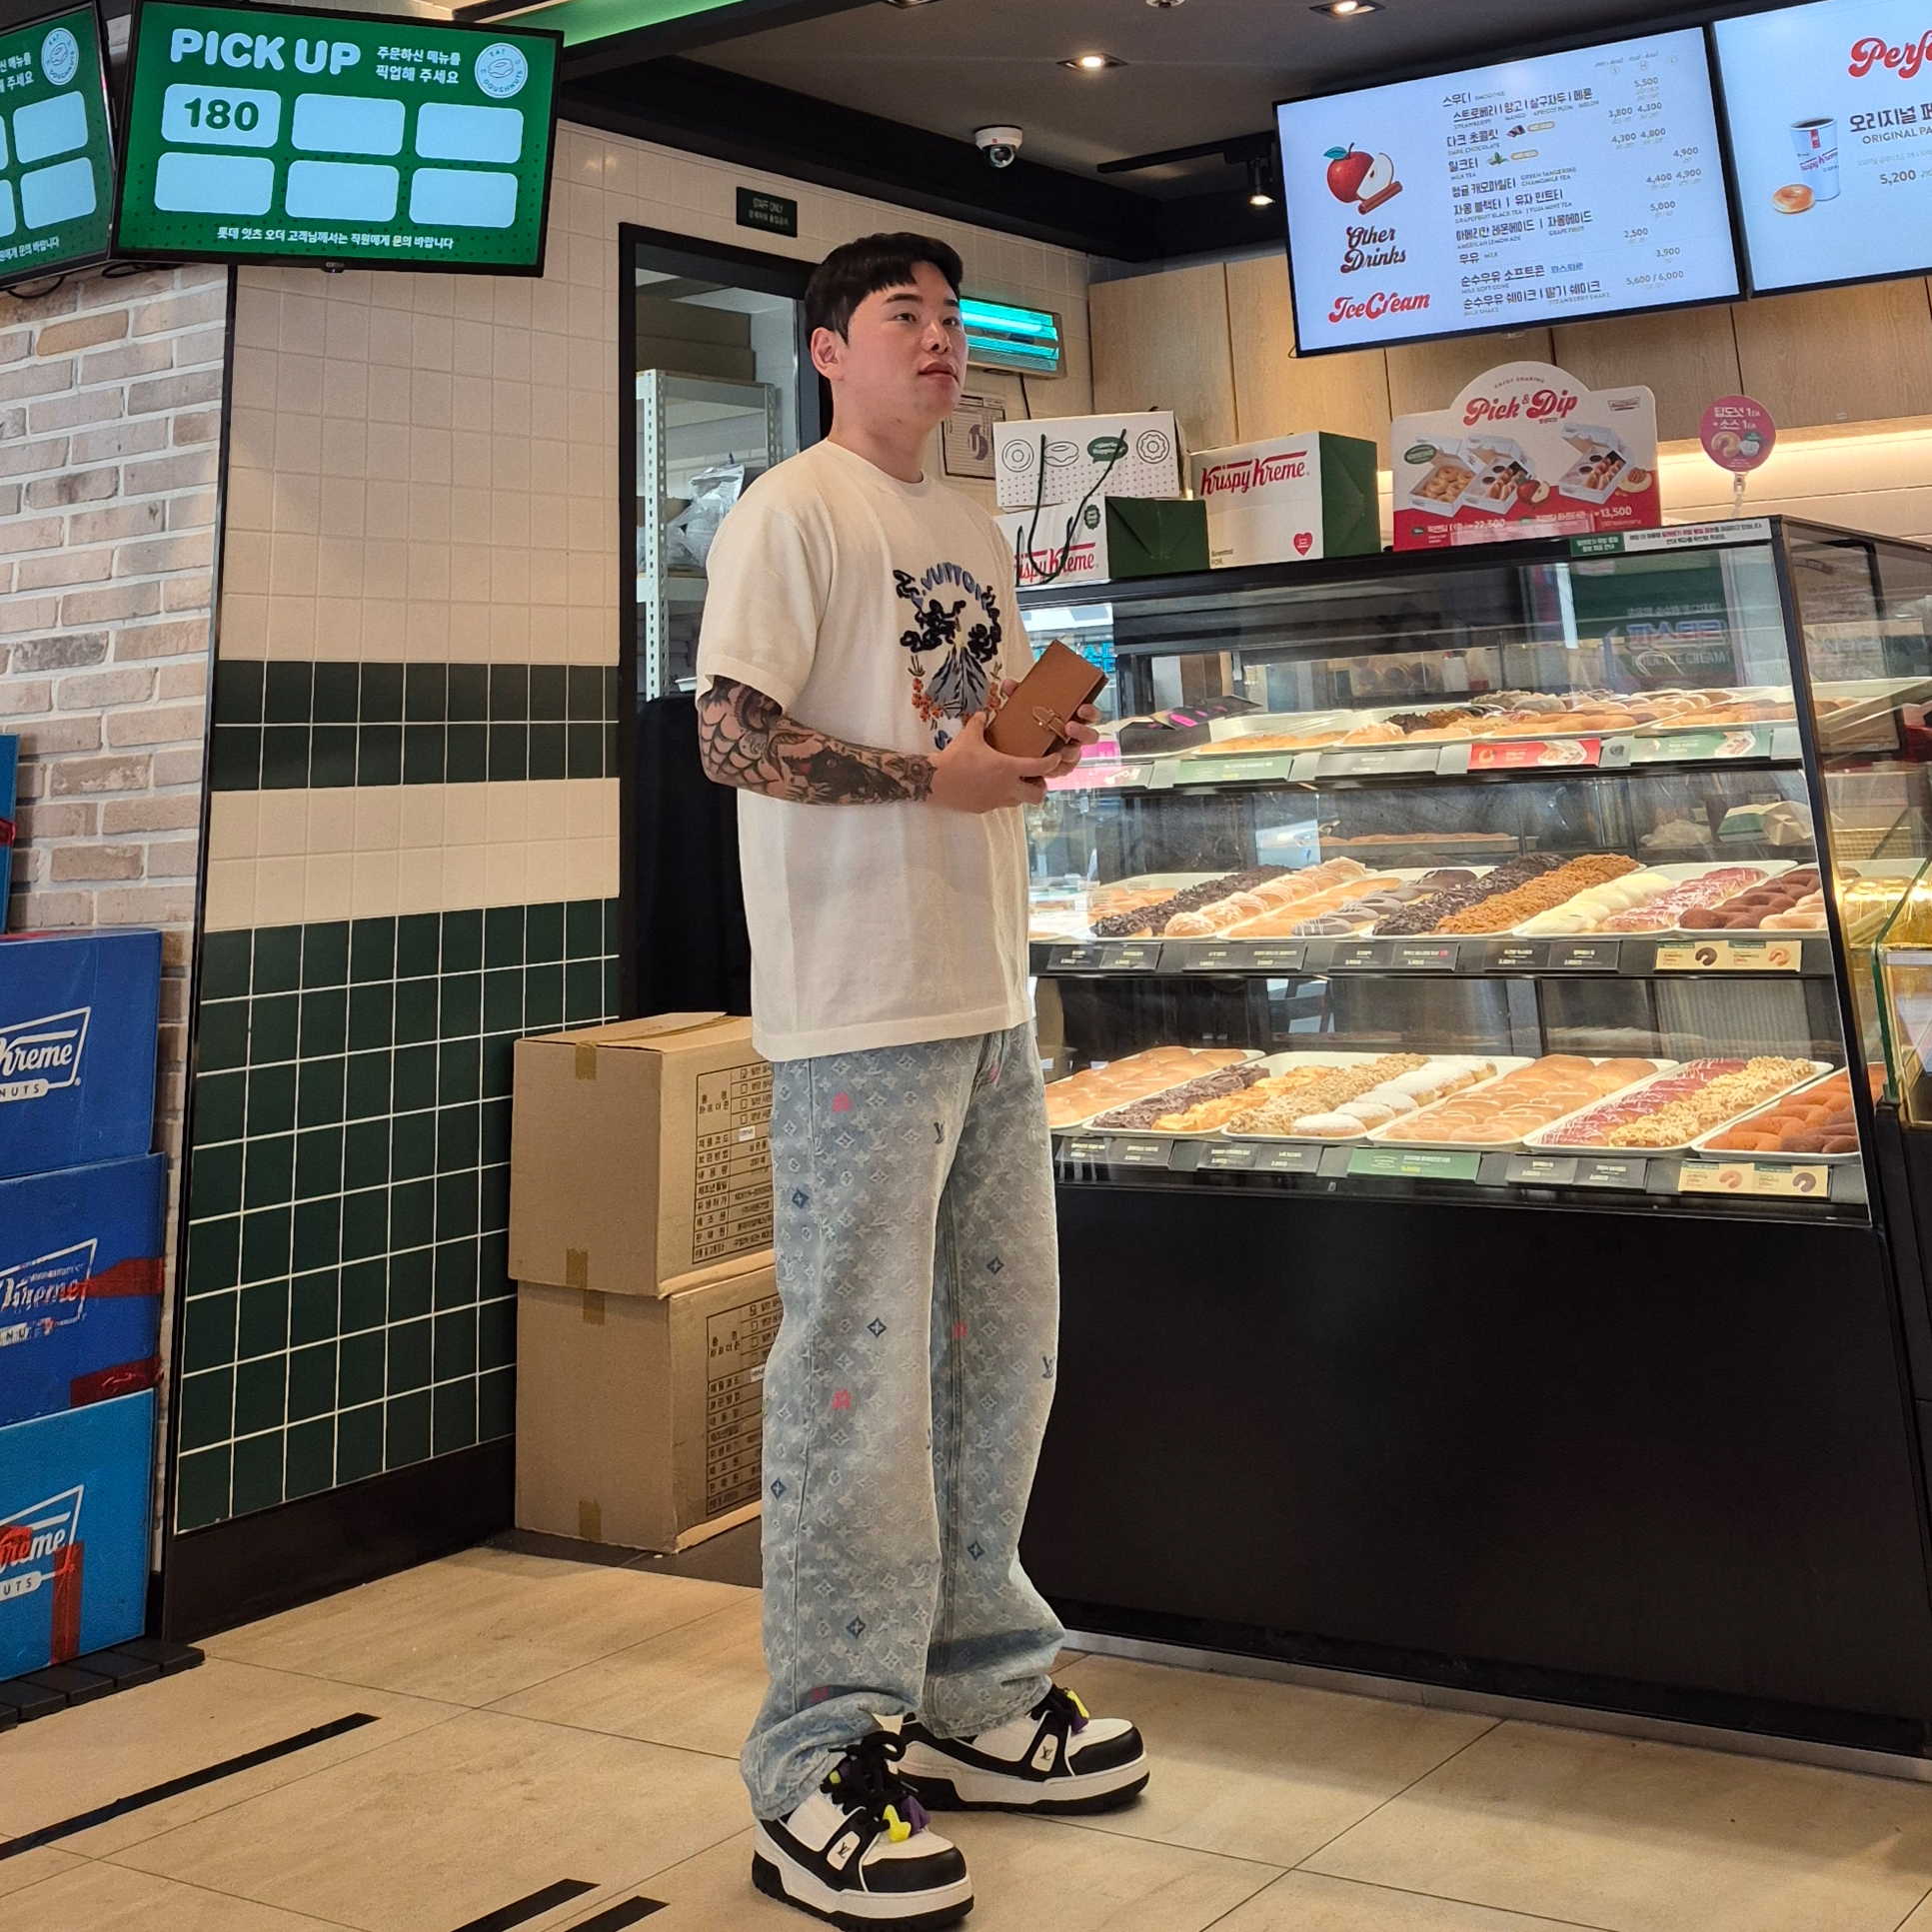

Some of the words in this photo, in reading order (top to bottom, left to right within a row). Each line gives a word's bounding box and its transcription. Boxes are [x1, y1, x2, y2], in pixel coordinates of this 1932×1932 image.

[170, 28, 285, 71] PICK
[295, 38, 361, 75] UP
[377, 46, 425, 62] 주문하신
[427, 50, 461, 66] 메뉴를
[376, 65, 416, 82] 픽업해
[420, 68, 460, 84] 주세요
[1442, 92, 1471, 107] 스무디
[184, 97, 259, 132] 180
[1453, 105, 1497, 121] 스트로베리
[1849, 106, 1916, 132] 오리지널
[1446, 133, 1465, 148] 다크
[1862, 127, 1917, 145] ORIGINAL
[1673, 146, 1698, 158] 4,900
[1646, 173, 1672, 184] 4,400
[1676, 168, 1702, 180] 4,900
[1880, 170, 1916, 186] 5,200
[1515, 193, 1532, 206] 유자
[1650, 201, 1676, 212] 5,000
[264, 229, 285, 242] 오더
[1346, 225, 1396, 248] Other
[1624, 228, 1648, 239] 2,500
[1340, 246, 1405, 274] Drinks
[1459, 252, 1479, 264] 우유
[1656, 247, 1680, 258] 3,900
[1461, 271, 1501, 287] 순수우유
[1504, 265, 1545, 282] 소프트콘
[1626, 275, 1651, 286] 5,600
[1659, 270, 1684, 282] 6,000
[1463, 294, 1503, 310] 순수우유
[1462, 396, 1520, 427] Pick
[1526, 389, 1578, 419] Dip
[1720, 420, 1741, 430] 소스
[1200, 460, 1252, 497] Krispy
[1252, 451, 1307, 487] Kreme
